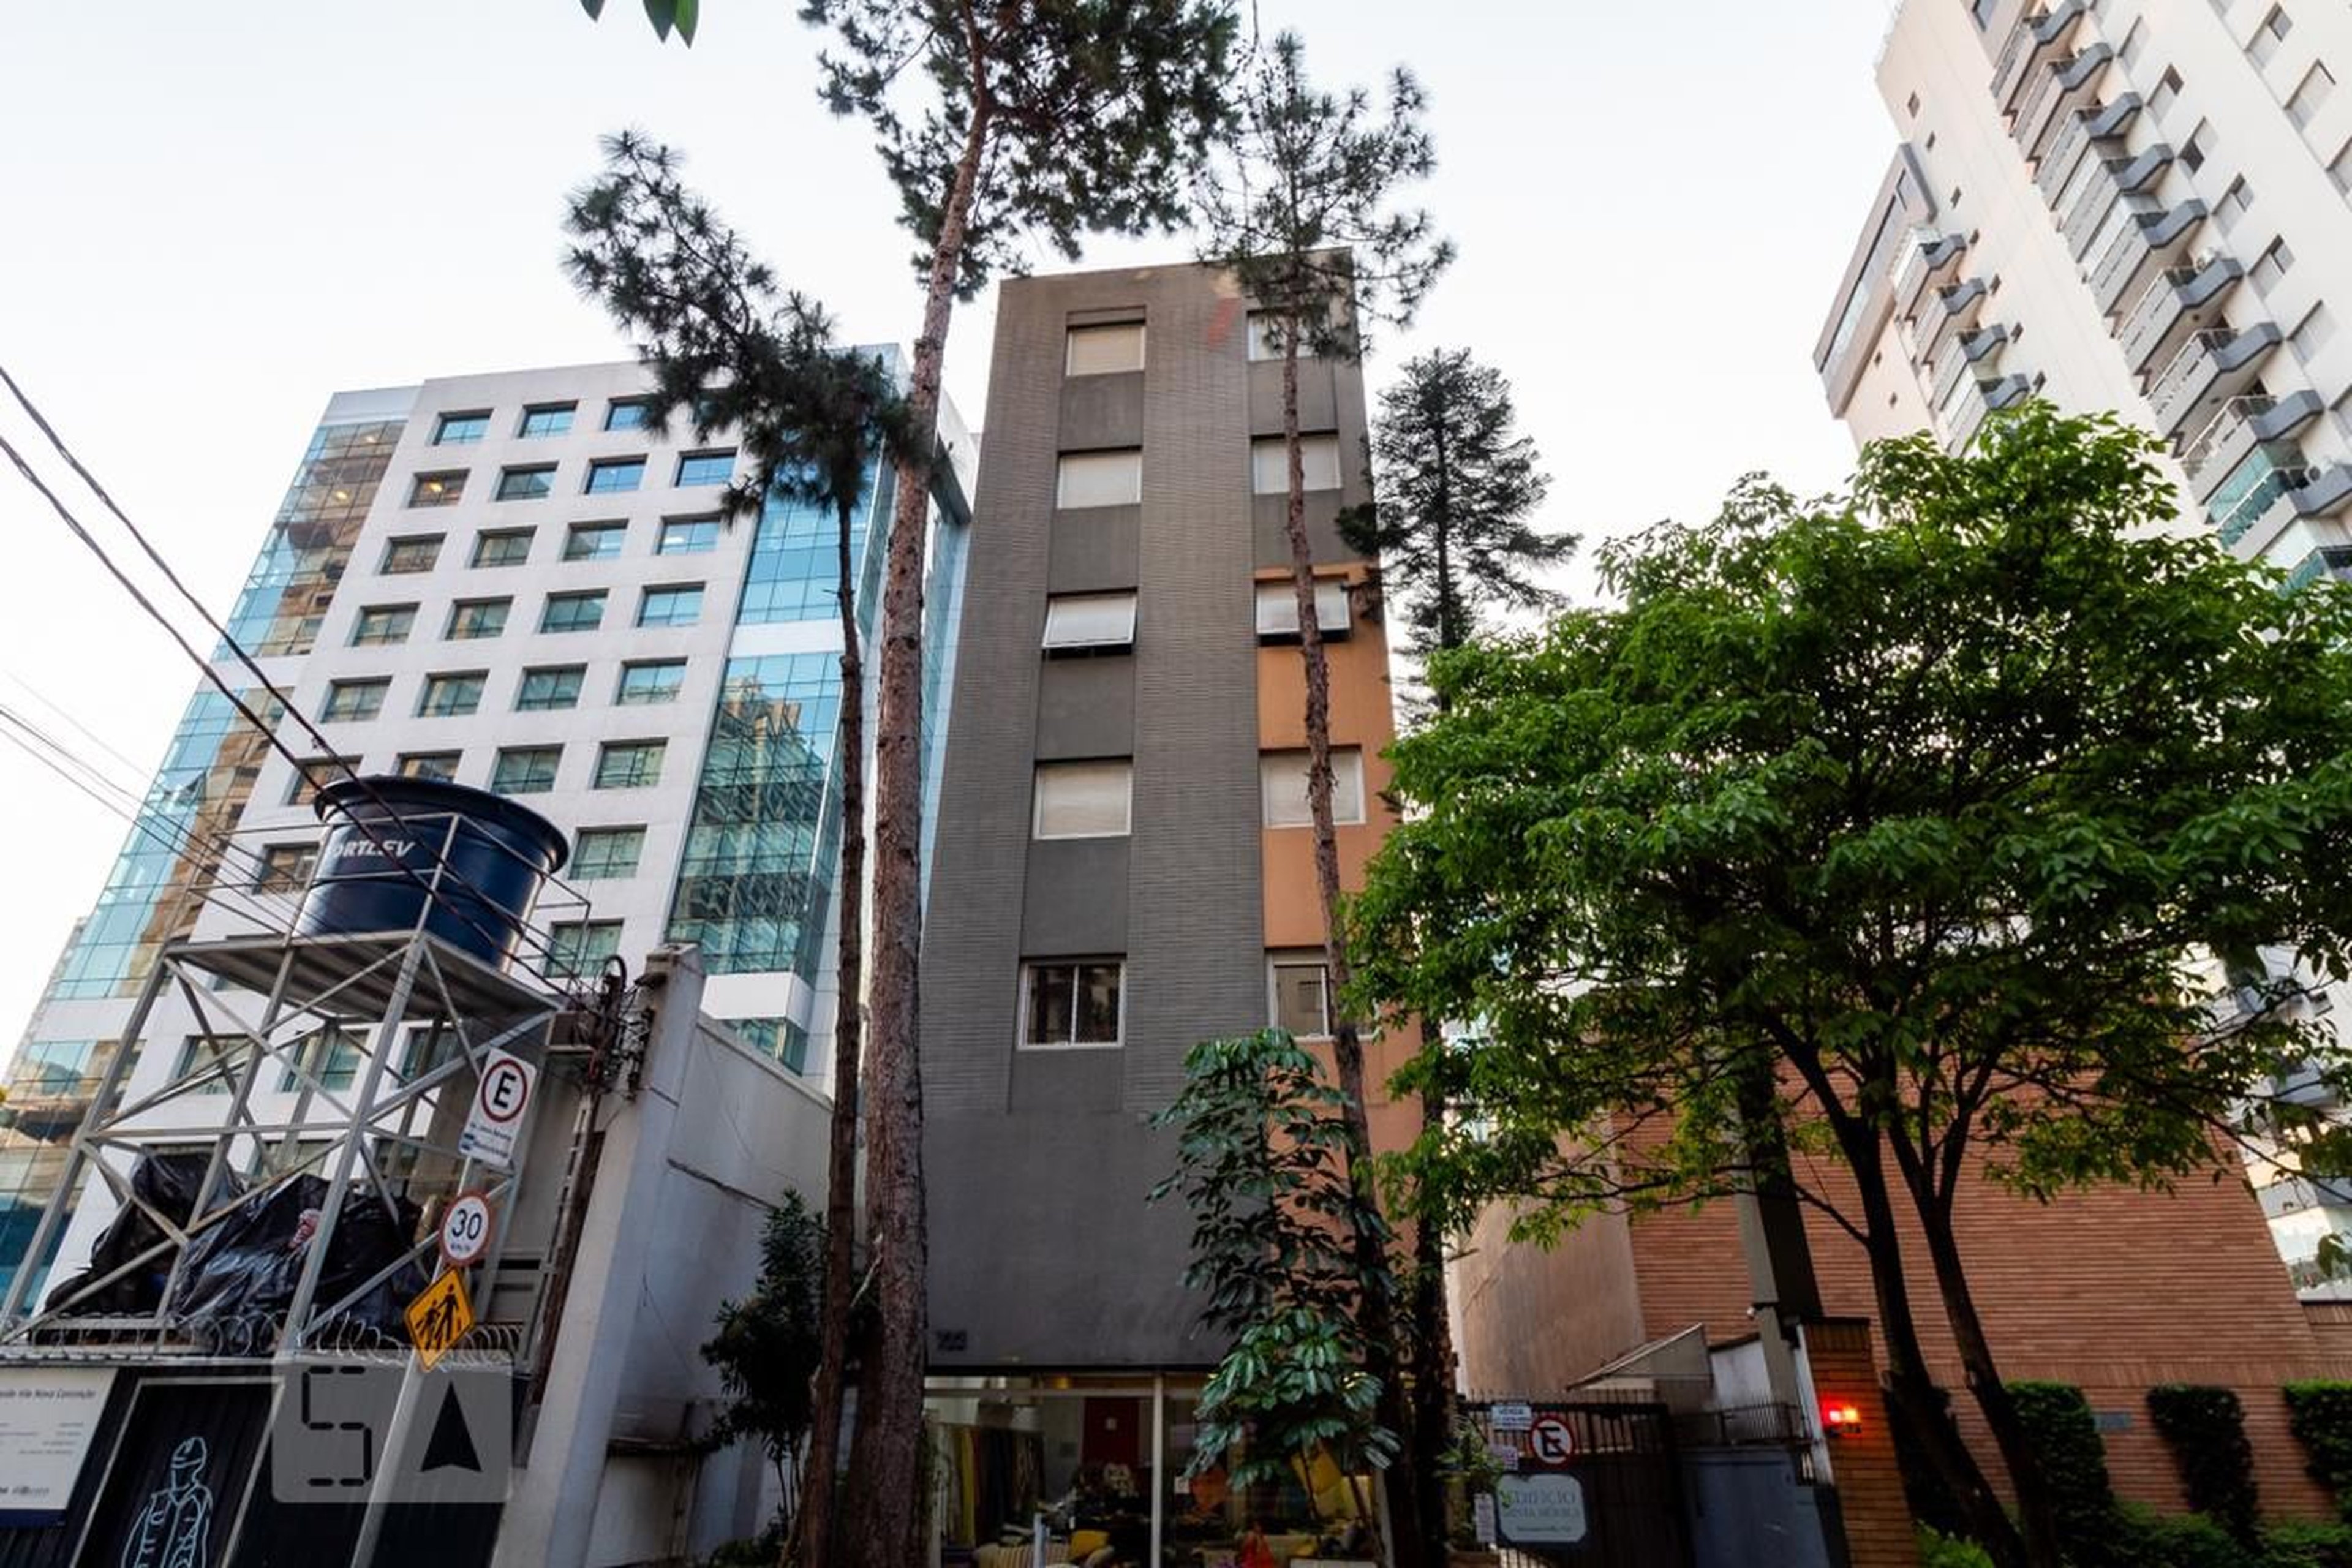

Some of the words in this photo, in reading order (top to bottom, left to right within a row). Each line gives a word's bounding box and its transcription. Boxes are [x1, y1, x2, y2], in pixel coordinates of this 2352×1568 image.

[492, 1071, 516, 1109] E
[451, 1208, 482, 1240] 30
[1539, 1427, 1564, 1457] E
